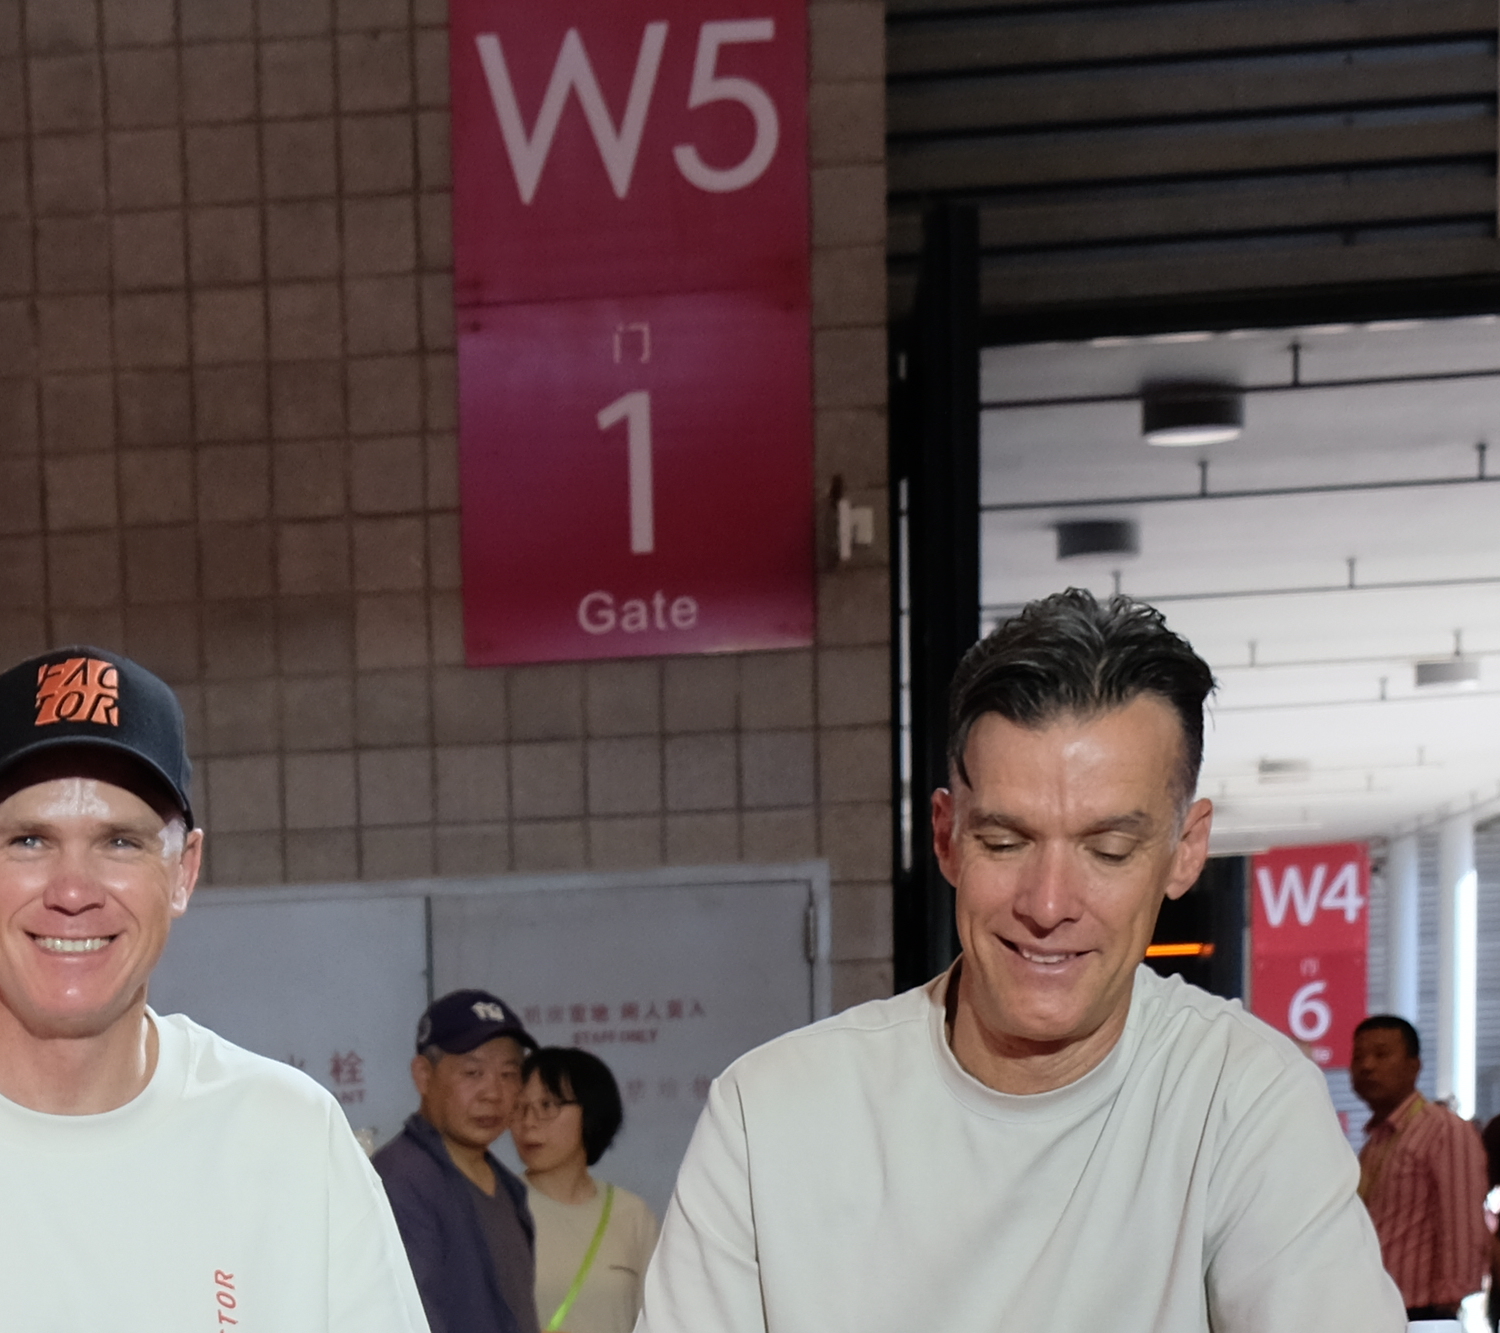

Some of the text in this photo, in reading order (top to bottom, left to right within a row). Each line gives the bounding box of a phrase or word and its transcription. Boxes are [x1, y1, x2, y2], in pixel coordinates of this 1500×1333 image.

[475, 20, 780, 204] W5
[611, 323, 652, 365] 门
[596, 391, 655, 555] 1
[576, 591, 699, 635] Gate
[1256, 860, 1364, 928] W4
[1289, 980, 1332, 1042] 6
